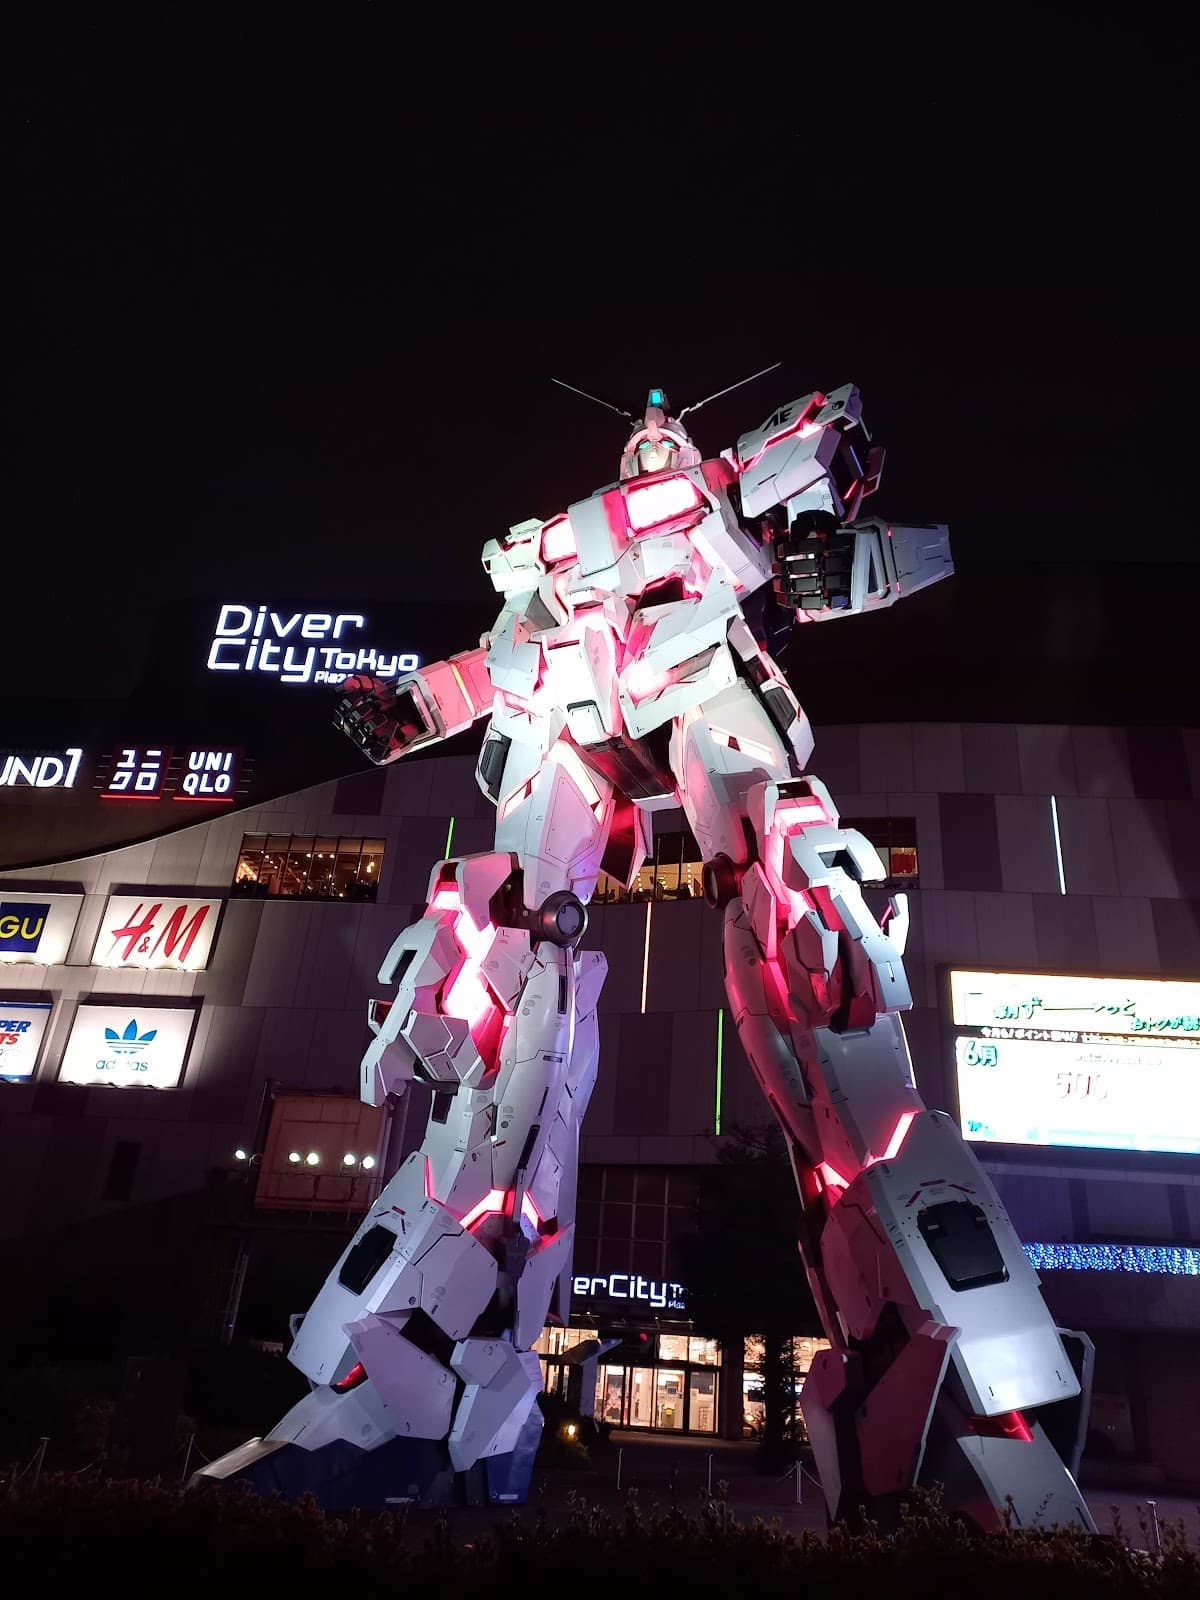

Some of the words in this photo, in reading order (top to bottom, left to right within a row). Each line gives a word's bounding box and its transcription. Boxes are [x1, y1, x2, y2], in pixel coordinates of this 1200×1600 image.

[215, 604, 364, 639] Diver
[207, 638, 316, 683] City
[188, 751, 233, 771] UNI
[182, 773, 231, 795] QLO
[0, 915, 44, 940] GU
[106, 903, 211, 963] H&M
[571, 1274, 667, 1307] erCity
